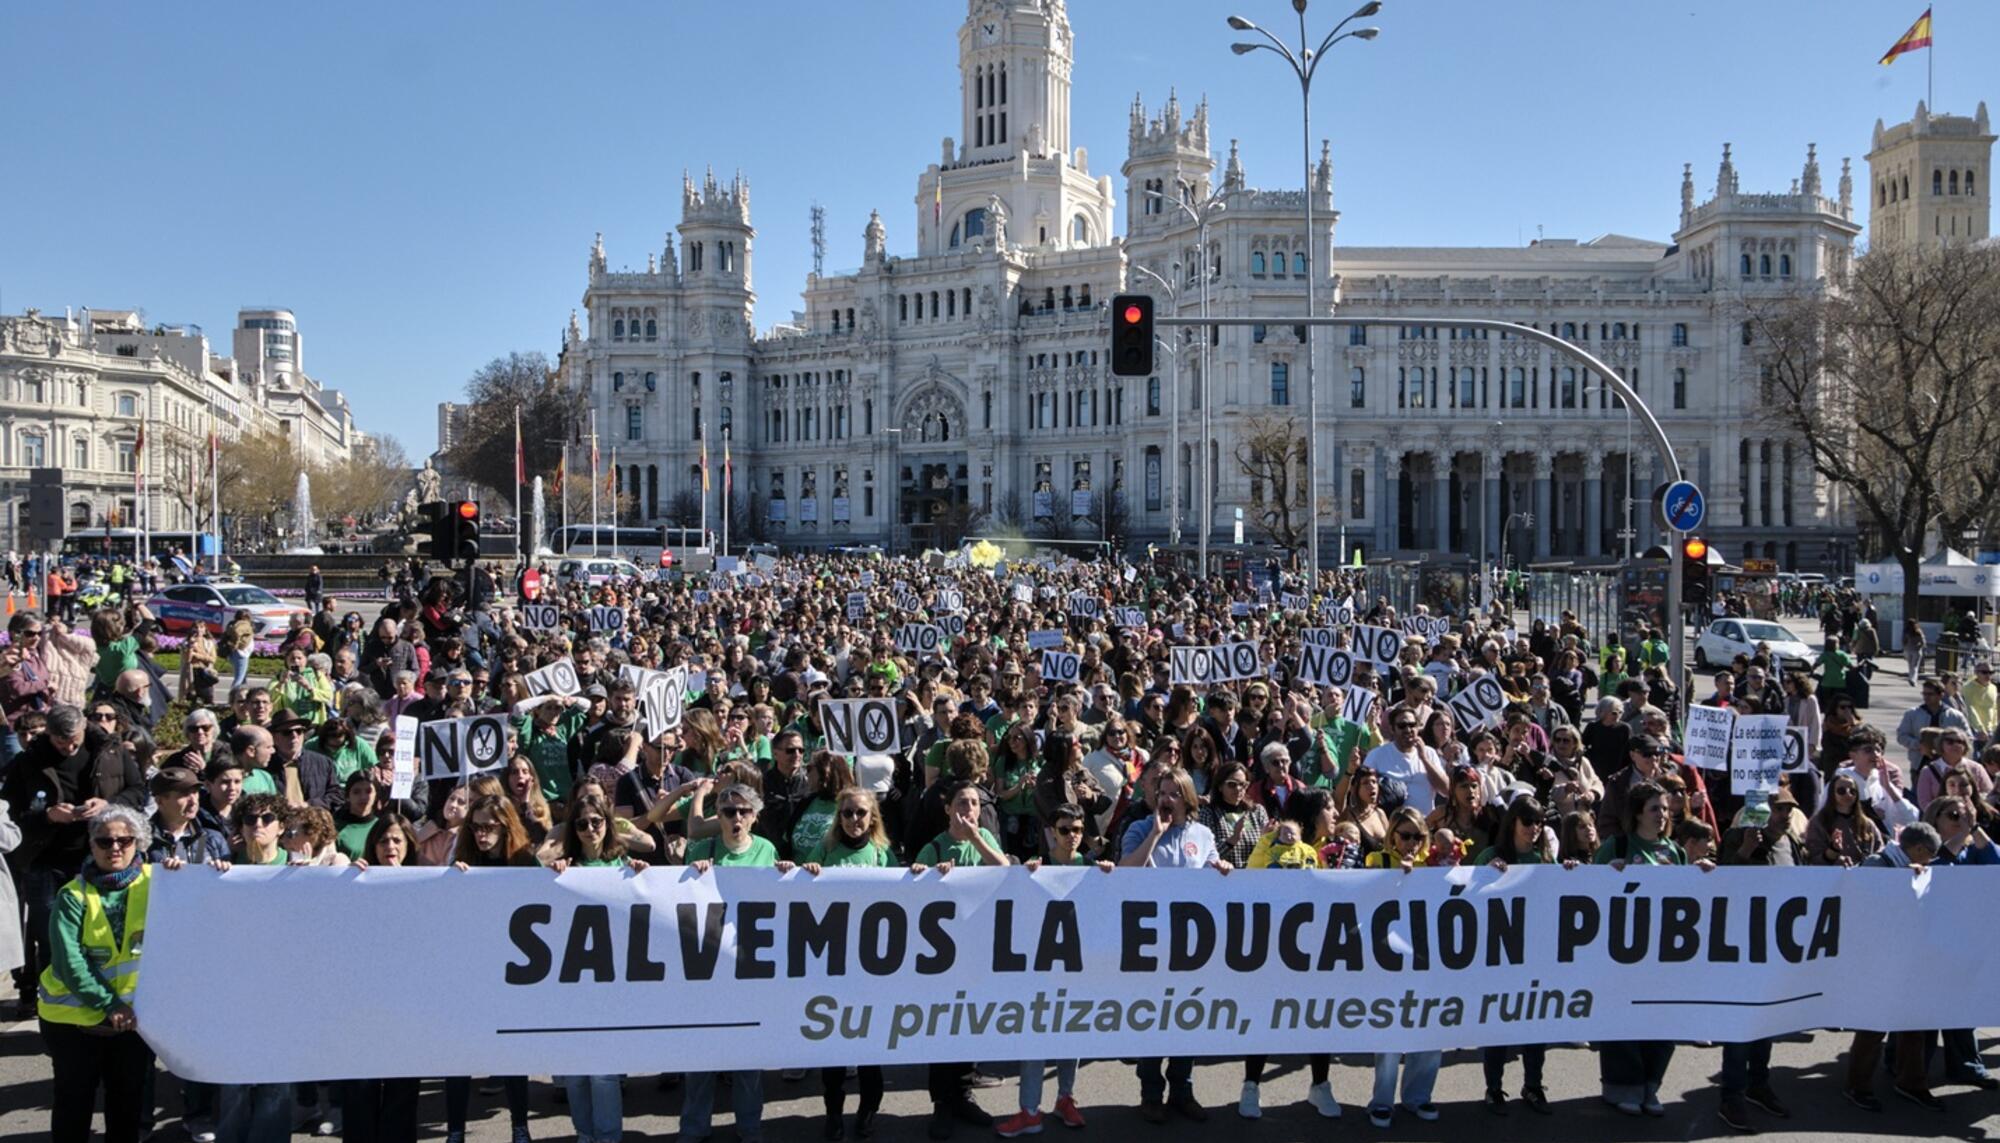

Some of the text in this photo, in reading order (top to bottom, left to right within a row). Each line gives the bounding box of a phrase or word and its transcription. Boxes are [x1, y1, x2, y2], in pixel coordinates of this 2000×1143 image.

[711, 577, 727, 591] NO
[897, 592, 919, 611] NO
[938, 590, 962, 609] NO
[1072, 598, 1095, 614] NO
[1288, 597, 1307, 609] NO
[525, 607, 556, 628] NO
[592, 608, 623, 629] NO
[937, 615, 962, 636] NO
[1326, 608, 1350, 624] NO
[1403, 616, 1427, 636] NO
[1429, 618, 1447, 635] NO
[902, 625, 937, 650] NO
[1302, 630, 1330, 647] NO
[1352, 626, 1399, 662] NO
[1042, 653, 1077, 679] NO
[1172, 648, 1210, 681] NO
[1211, 644, 1257, 679] NO
[1300, 645, 1351, 686] NO
[528, 662, 576, 696] NO
[647, 679, 678, 737] NO
[1451, 678, 1503, 729] NO
[821, 701, 895, 752] NO
[1735, 726, 1744, 739] La
[424, 717, 504, 776] NO
[1737, 749, 1746, 759] un
[1734, 769, 1745, 779] no
[505, 882, 1842, 985] SALVEMOS LA EDUCACIÓN PÚBLICA
[800, 979, 1594, 1050] Su privatización, nuestra ruina
